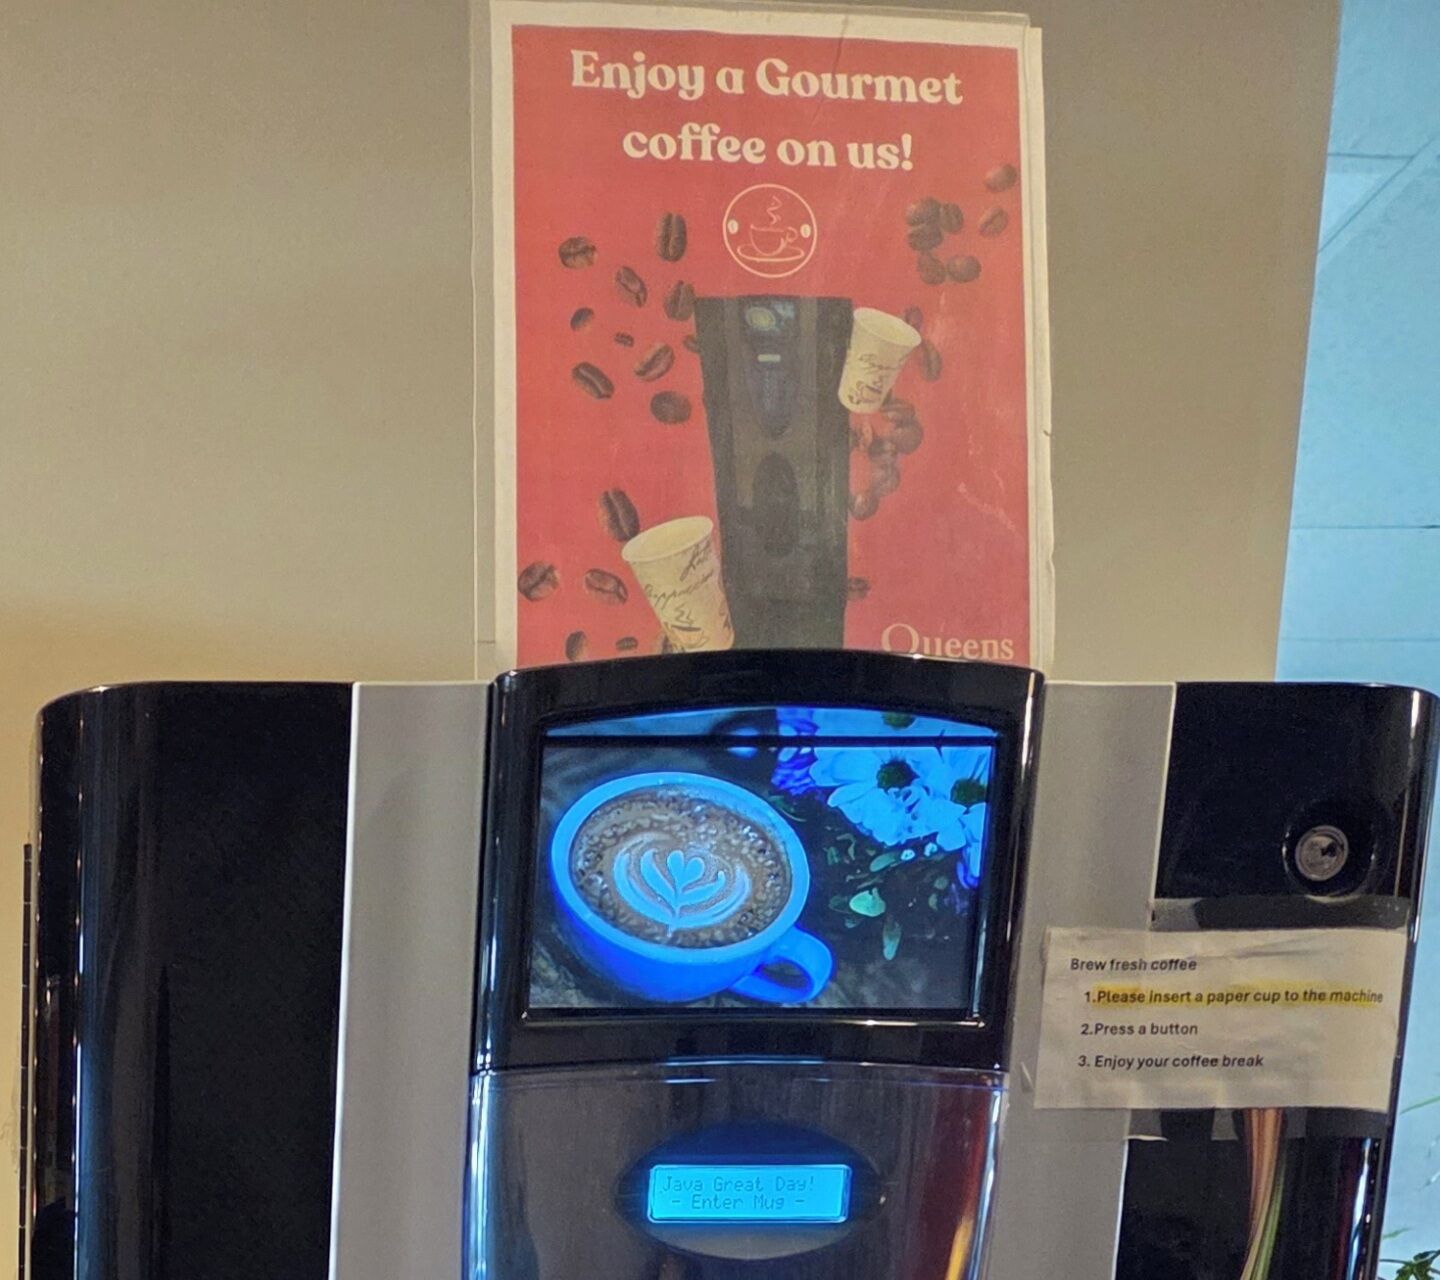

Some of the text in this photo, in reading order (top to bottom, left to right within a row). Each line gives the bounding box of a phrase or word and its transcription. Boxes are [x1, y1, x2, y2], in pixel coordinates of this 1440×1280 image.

[570, 49, 964, 105] Enjoy a Gourmet
[622, 122, 915, 171] coffee on us!
[881, 623, 1016, 661] Queens
[1070, 958, 1198, 971] Brew fresh coffee
[1149, 990, 1191, 1004] insert
[1194, 993, 1204, 1003] a
[1207, 992, 1250, 1006] paper
[1253, 991, 1281, 1005] cup
[1284, 990, 1299, 1002] to
[1303, 989, 1327, 1002] the
[1329, 989, 1384, 1004] machine
[1138, 1025, 1146, 1036] a
[1150, 1023, 1199, 1036] button
[1078, 1055, 1264, 1071] 3. Enjoy your coffee break
[662, 1175, 815, 1193] Java Great Day!
[691, 1194, 744, 1210] Enter
[753, 1194, 785, 1210] Mug
